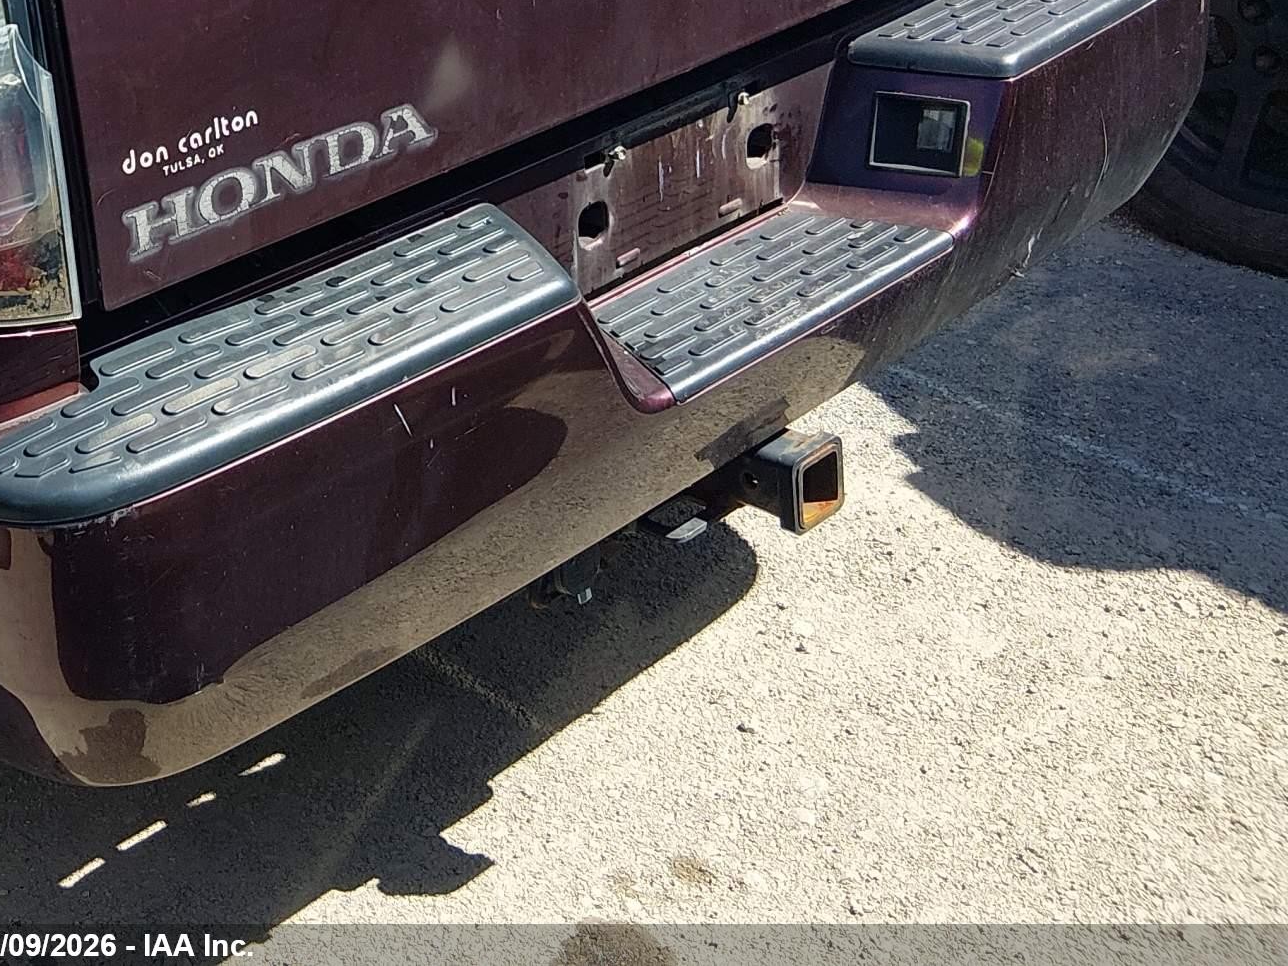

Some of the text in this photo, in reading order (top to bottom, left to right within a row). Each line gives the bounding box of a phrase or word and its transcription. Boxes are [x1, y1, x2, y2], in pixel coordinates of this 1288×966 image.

[122, 109, 259, 175] don carlton
[162, 143, 224, 176] TULSA, OK
[123, 104, 437, 262] HONDA
